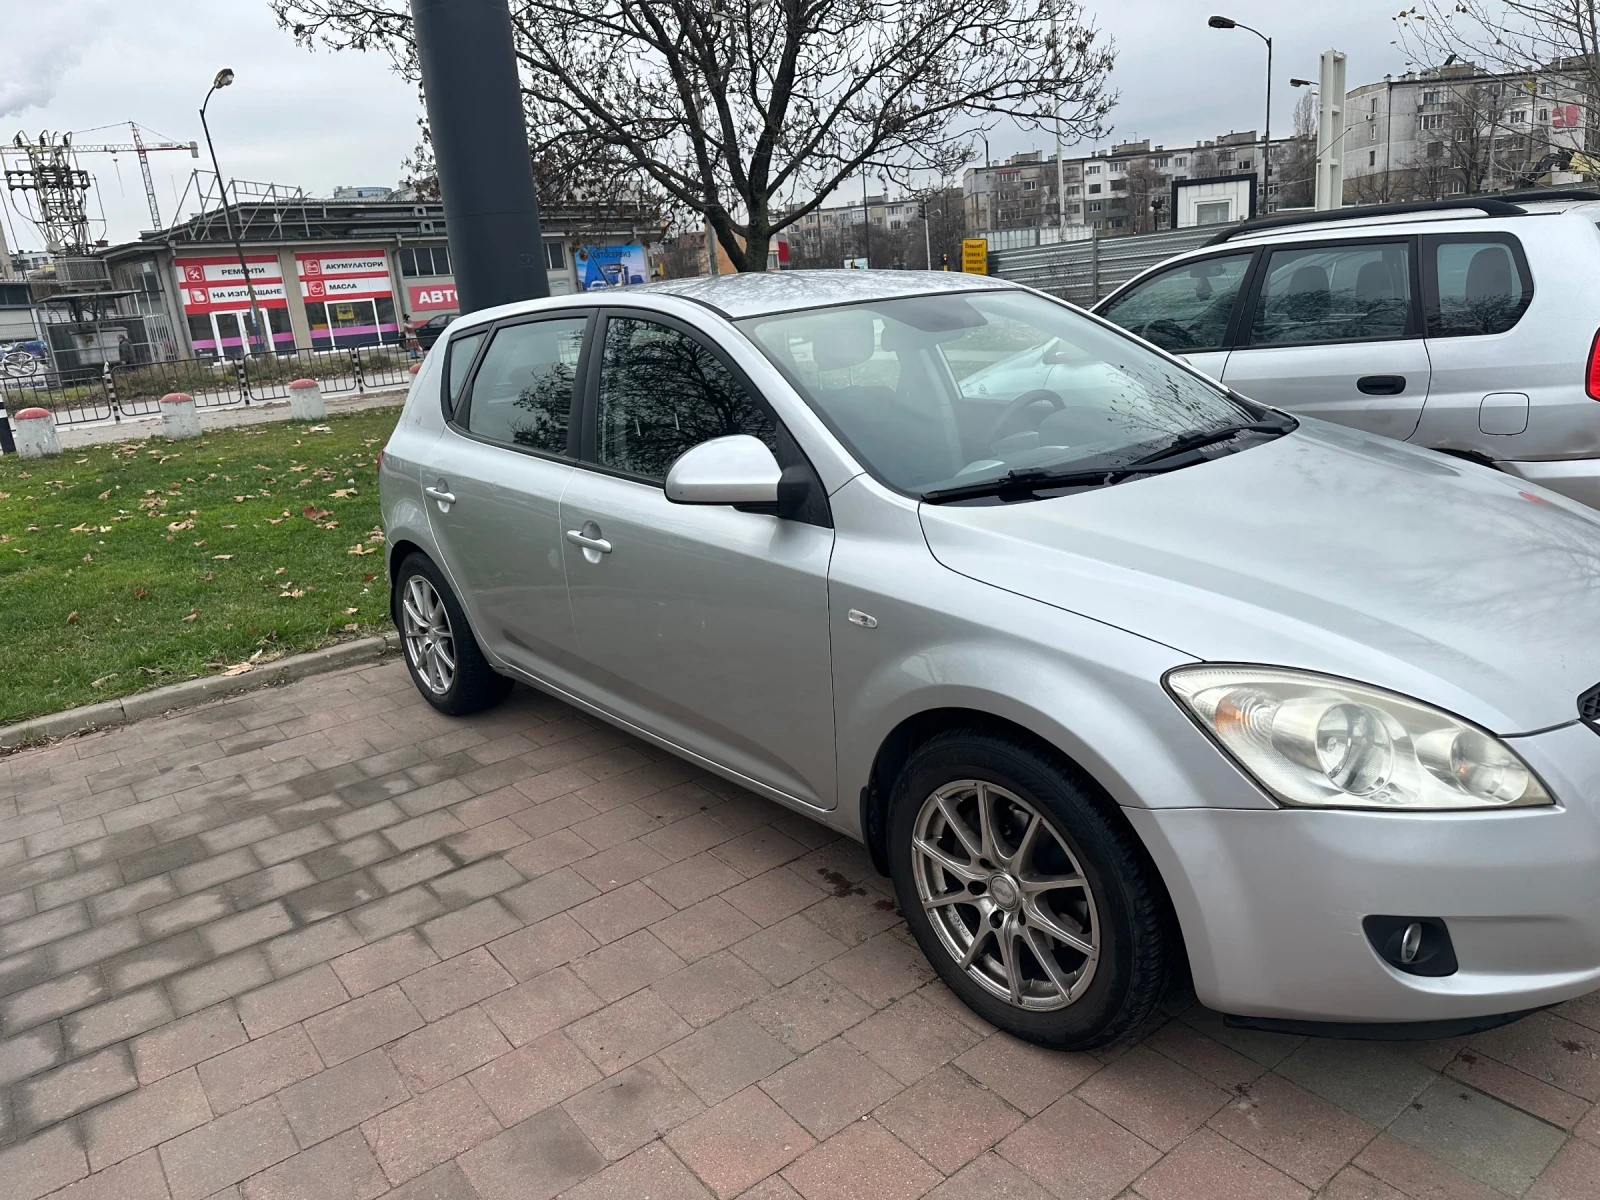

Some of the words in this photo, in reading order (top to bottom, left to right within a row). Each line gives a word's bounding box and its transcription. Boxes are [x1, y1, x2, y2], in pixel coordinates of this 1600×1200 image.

[594, 250, 631, 258] АВТОСЕРВИЗ
[326, 261, 384, 270] АКУМУЛАТОРИ
[221, 267, 265, 275] РЕМОНТИ
